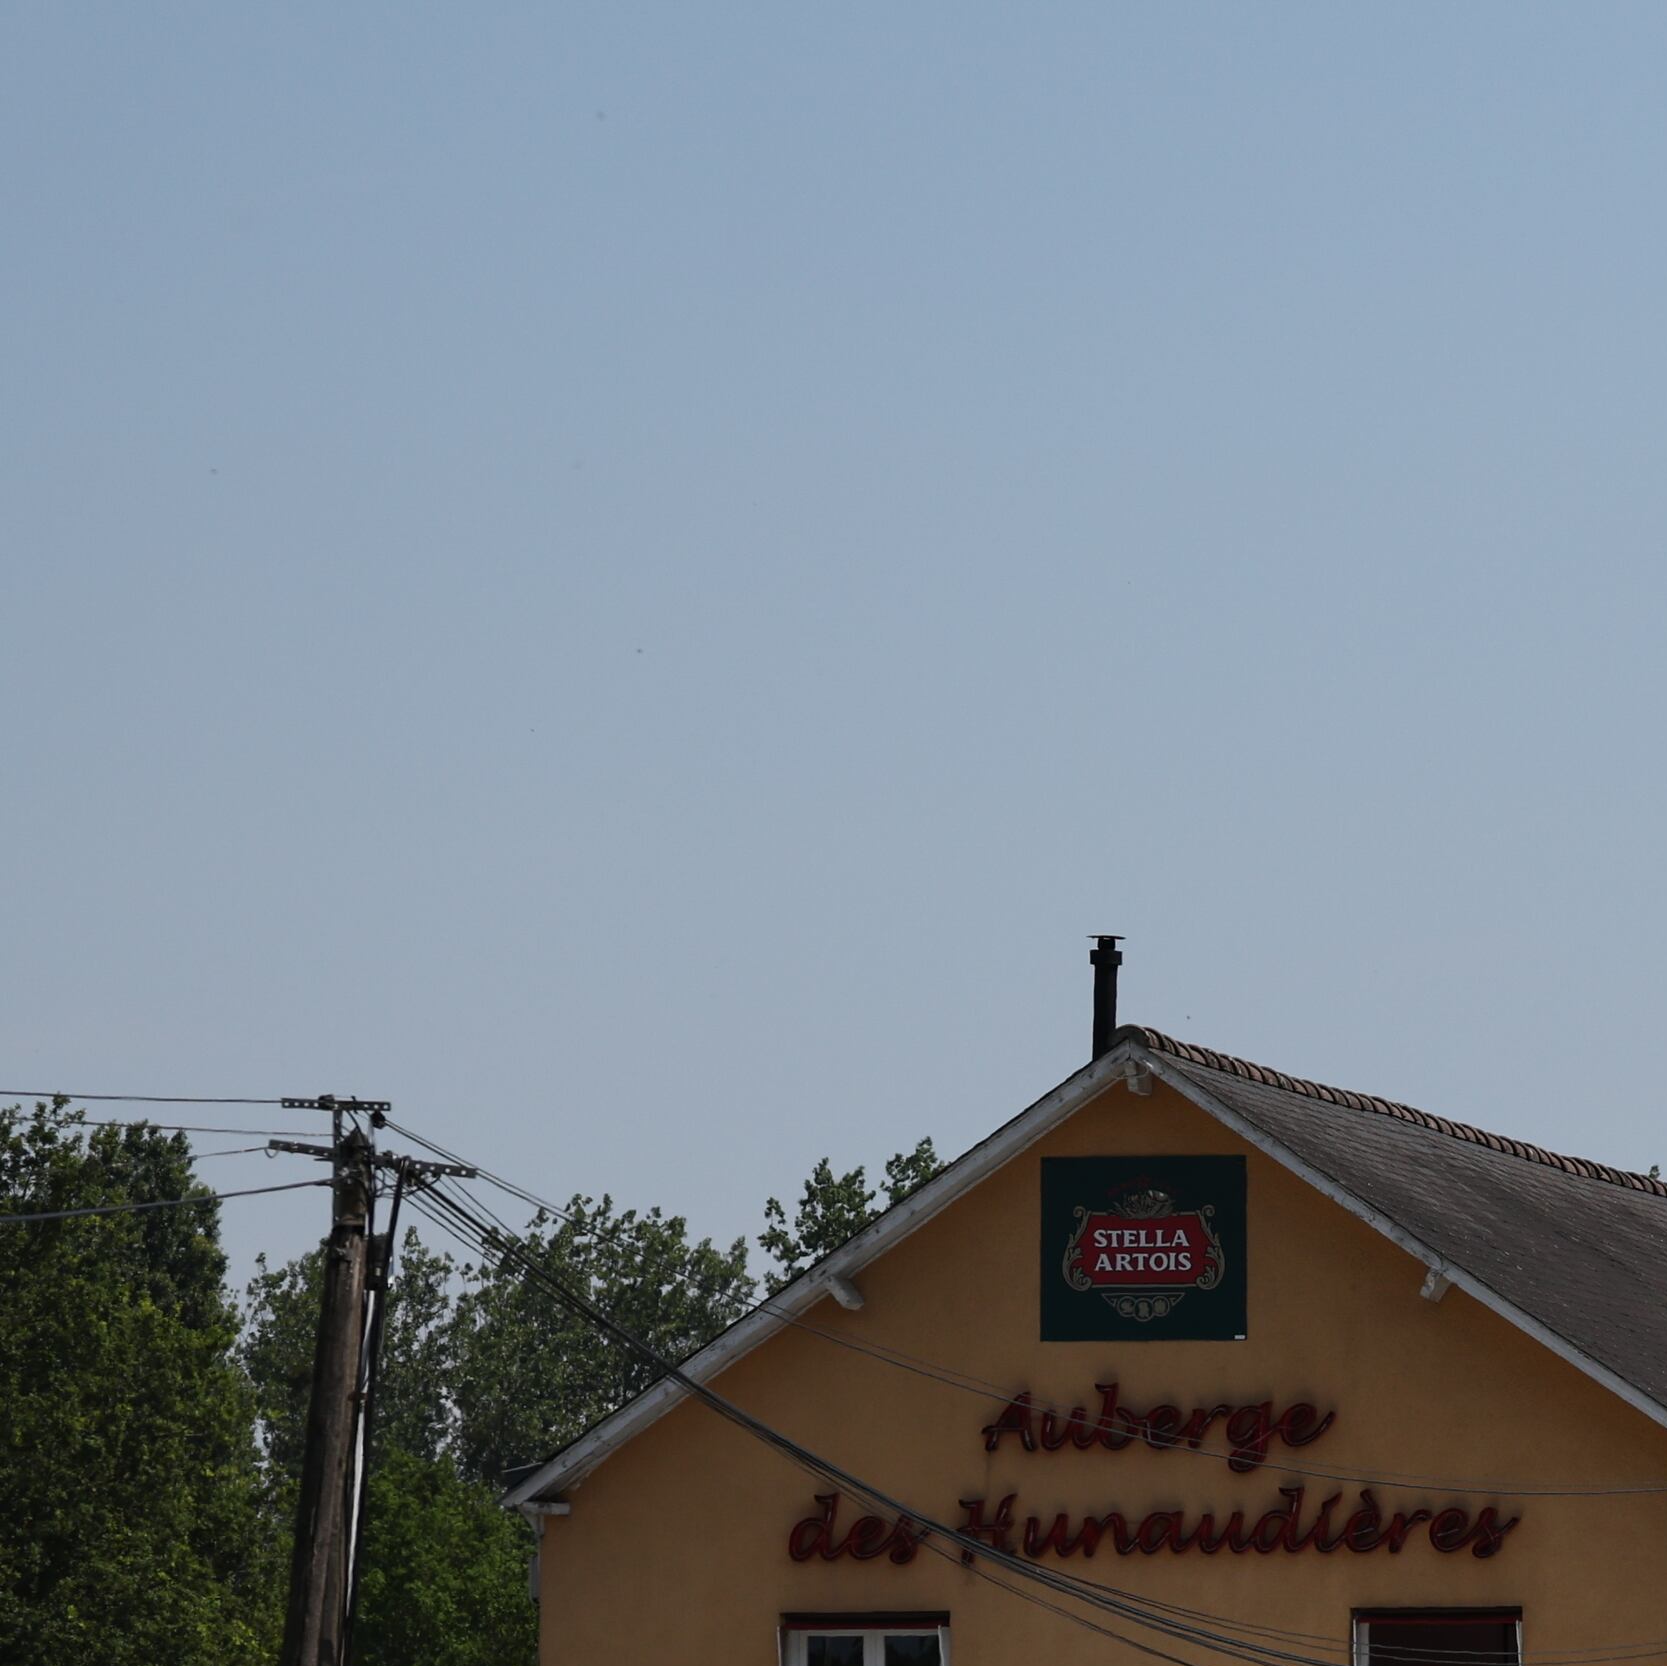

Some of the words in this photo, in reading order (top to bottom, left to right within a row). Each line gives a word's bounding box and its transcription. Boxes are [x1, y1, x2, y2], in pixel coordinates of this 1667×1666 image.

[1093, 1229, 1190, 1248] STELLA
[1094, 1252, 1192, 1271] ARTOIS
[981, 1383, 1337, 1473] Auberge
[788, 1494, 934, 1565] des
[958, 1486, 1522, 1567] Hunaudières
